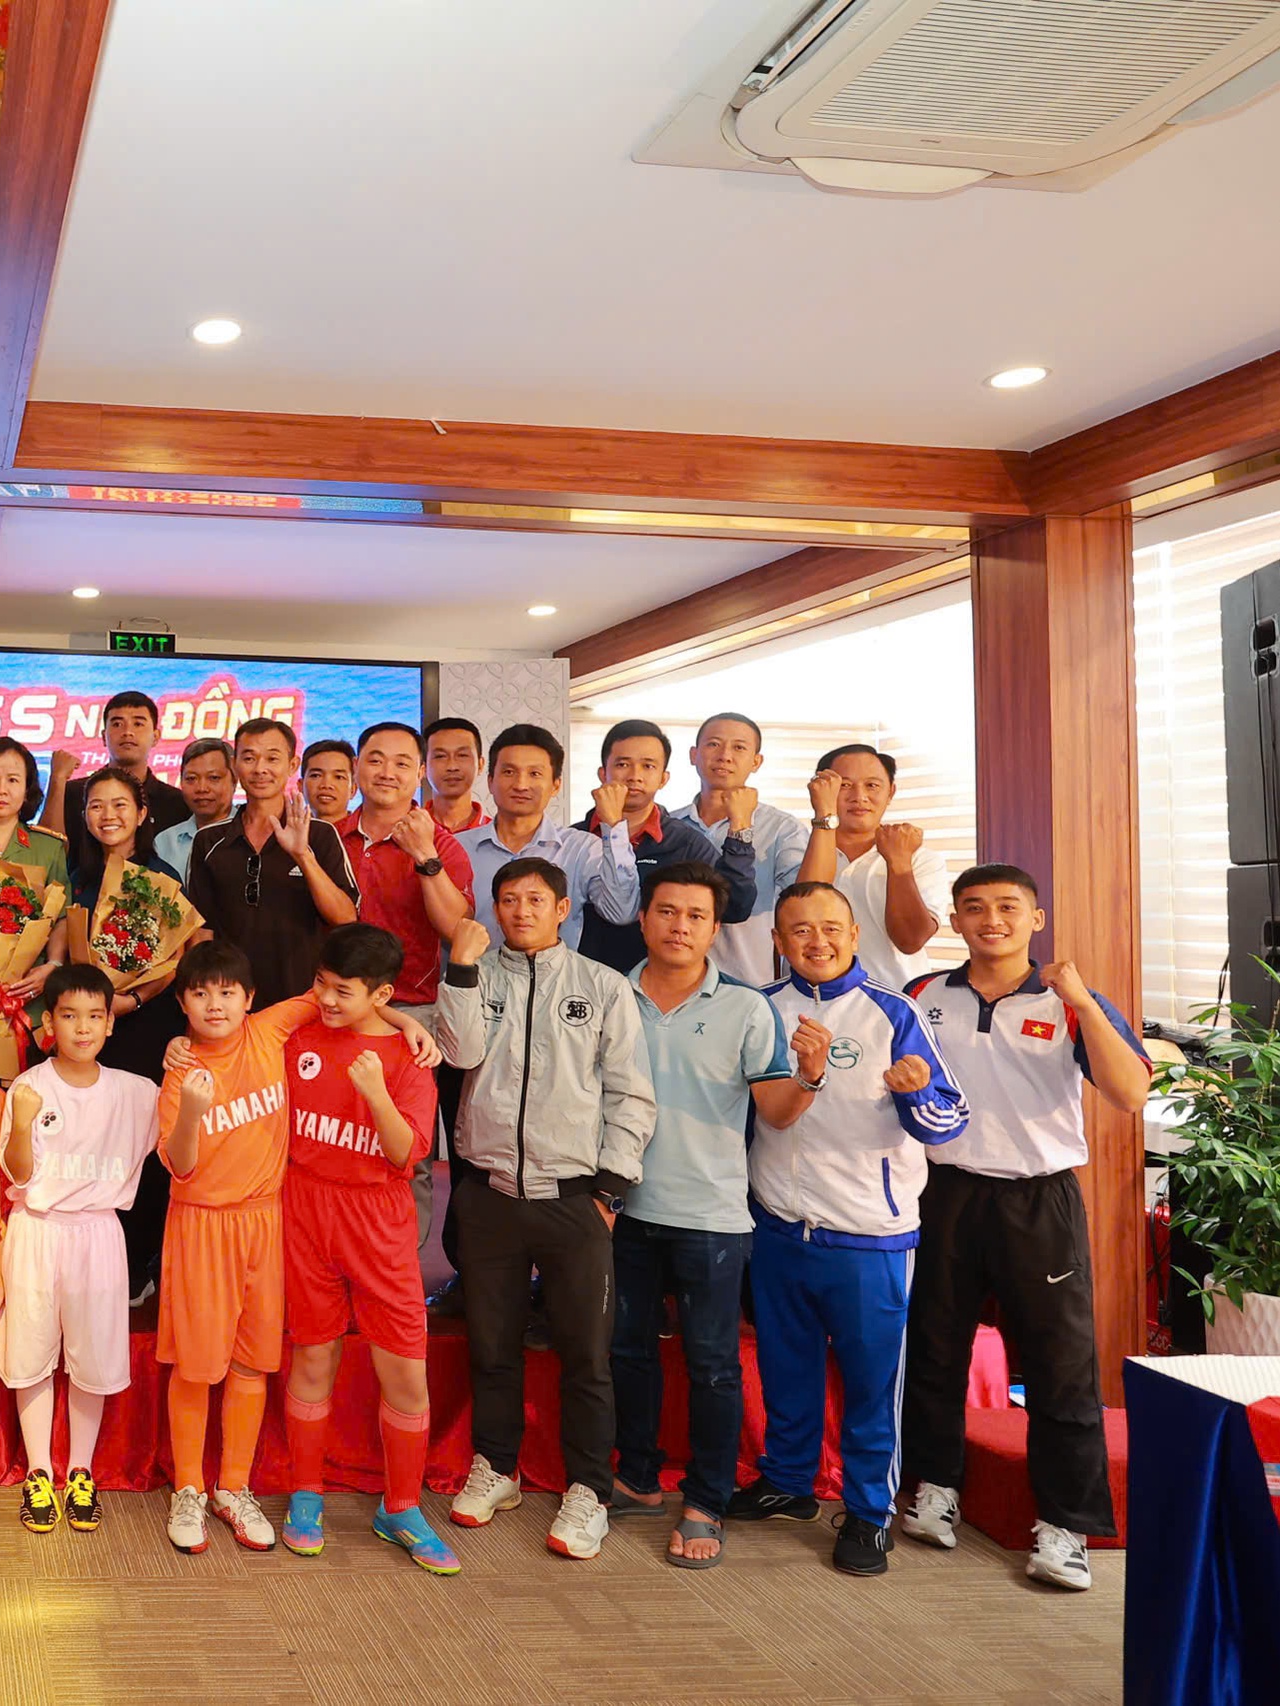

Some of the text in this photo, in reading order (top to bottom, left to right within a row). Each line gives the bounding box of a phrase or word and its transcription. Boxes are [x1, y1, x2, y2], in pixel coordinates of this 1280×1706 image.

[115, 635, 168, 652] EXIT
[161, 682, 295, 740] ĐỒNG
[153, 753, 185, 767] PH
[201, 1081, 285, 1135] YAMAHA
[295, 1109, 385, 1158] YAMAHA
